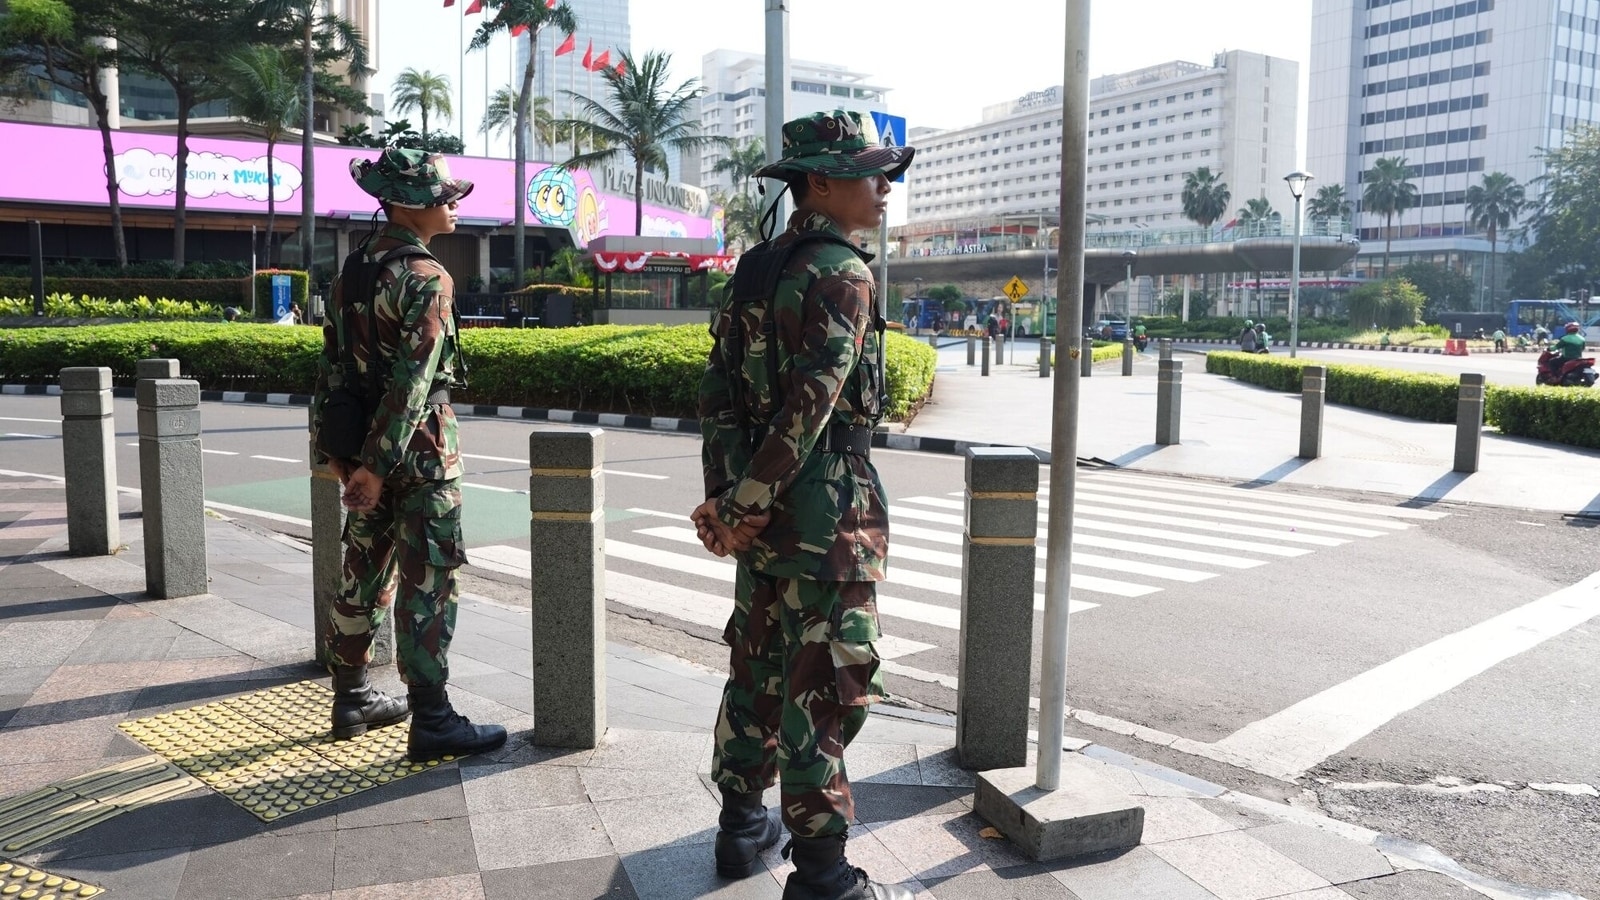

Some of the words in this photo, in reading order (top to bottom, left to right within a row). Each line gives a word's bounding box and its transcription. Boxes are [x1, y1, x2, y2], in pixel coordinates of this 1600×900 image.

[149, 165, 216, 183] cityision
[233, 169, 282, 186] MUKLY
[603, 164, 644, 197] PLAZ
[646, 178, 703, 213] INDONESIA
[963, 243, 987, 254] ASTRA
